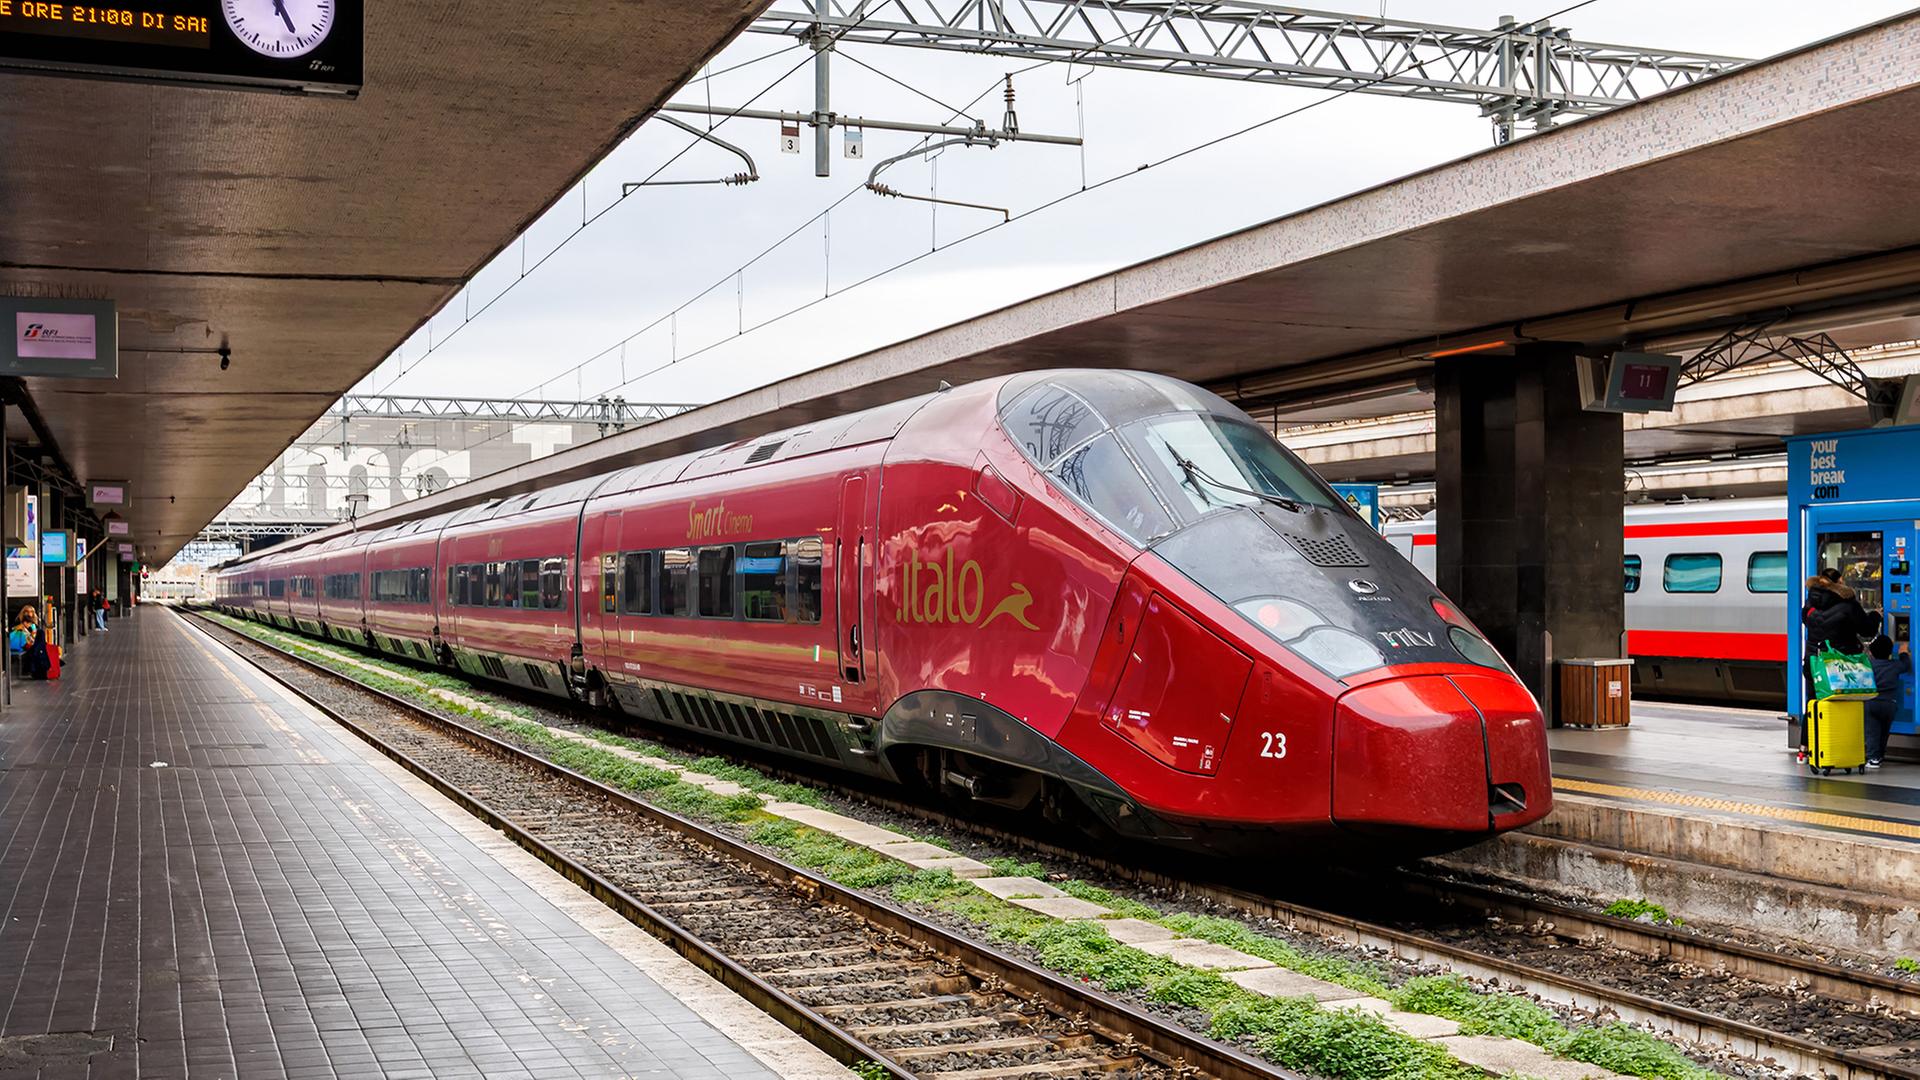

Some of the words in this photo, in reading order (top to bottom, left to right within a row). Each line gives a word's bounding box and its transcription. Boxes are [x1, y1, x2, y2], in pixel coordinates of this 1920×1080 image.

[22, 2, 63, 20] ORE
[72, 6, 133, 26] 21:00
[142, 12, 164, 29] DI
[787, 139, 795, 151] 3
[850, 145, 858, 156] 4
[42, 329, 59, 337] RFI
[1639, 374, 1652, 388] 11
[1811, 440, 1839, 457] your
[1811, 455, 1837, 470] best
[1811, 470, 1846, 486] break
[1810, 485, 1840, 500] .com
[686, 499, 725, 540] Smart
[724, 511, 753, 536] Cinema
[1261, 731, 1287, 759] 23
